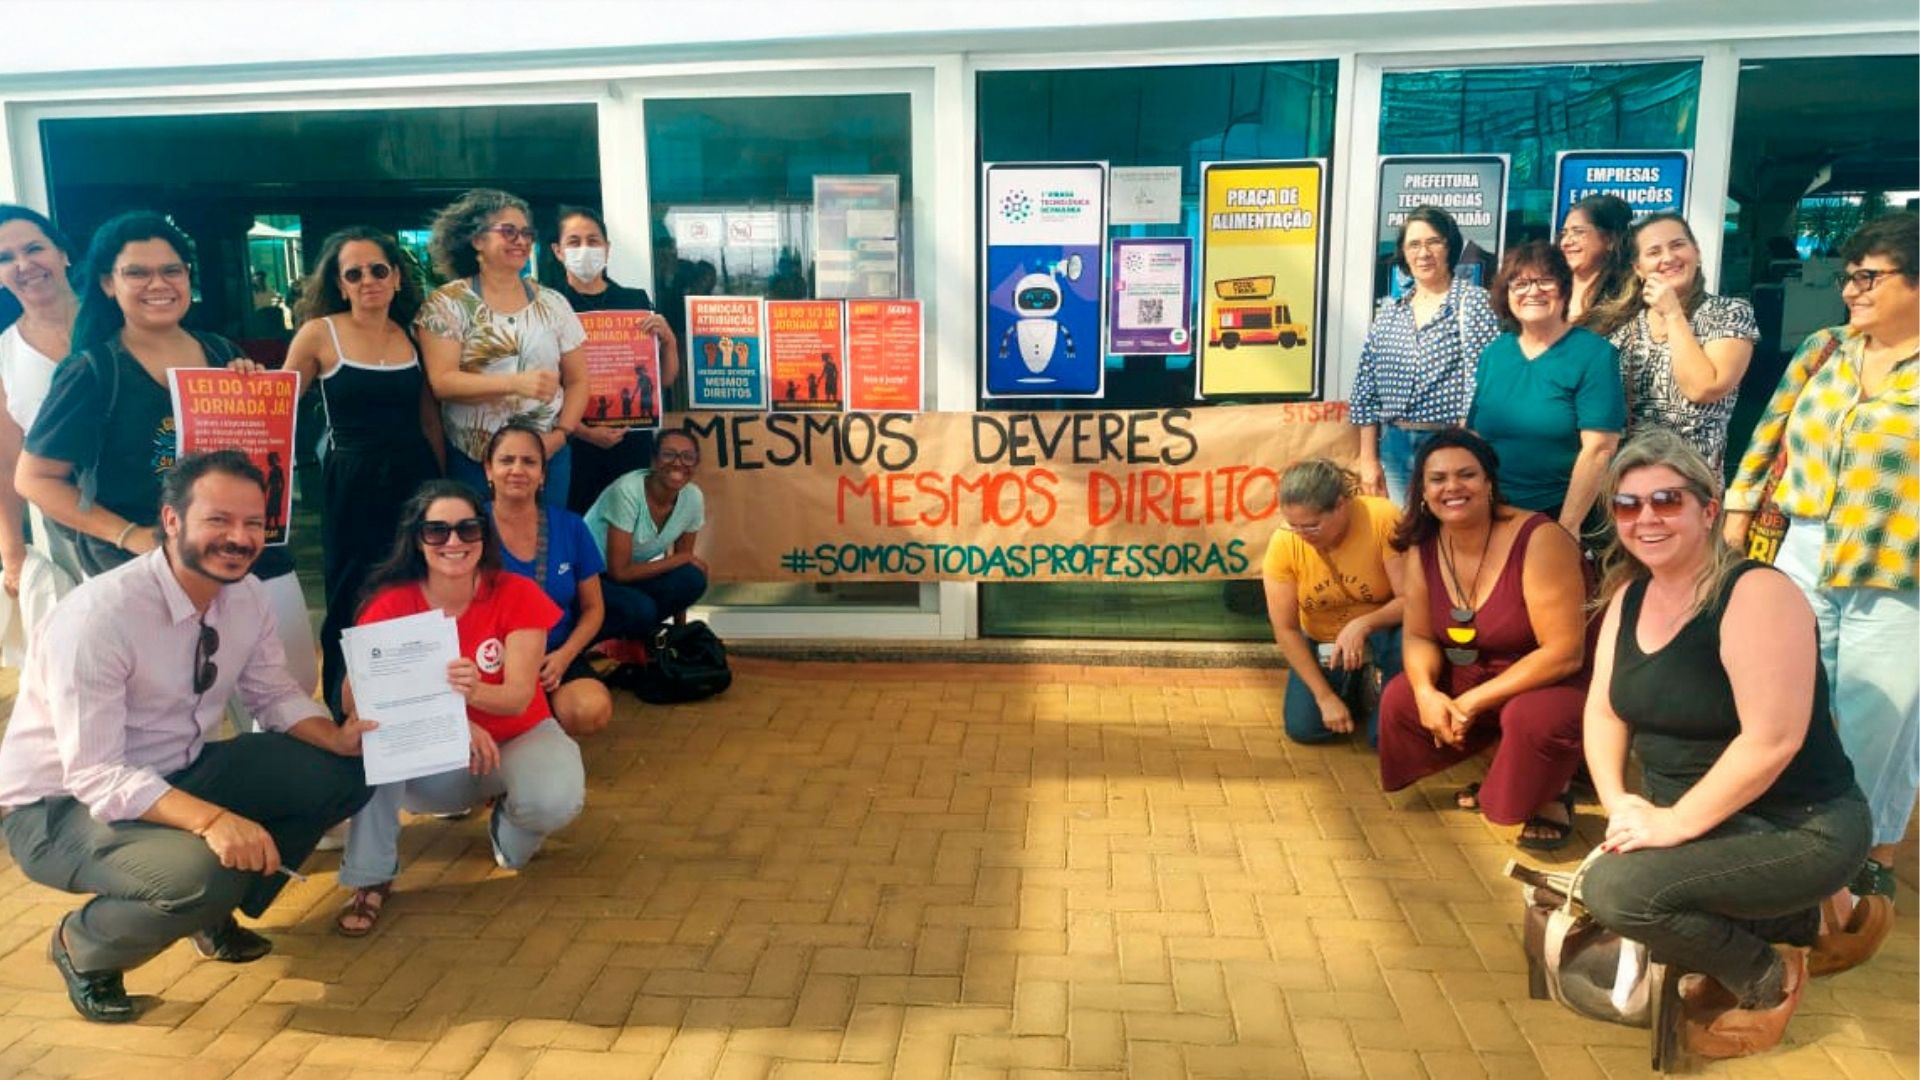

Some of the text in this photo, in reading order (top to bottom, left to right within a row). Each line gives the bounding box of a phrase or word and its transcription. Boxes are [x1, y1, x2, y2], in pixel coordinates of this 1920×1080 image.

[1404, 173, 1479, 188] PREFEITURA
[1587, 167, 1660, 182] EMPRESAS
[1227, 187, 1298, 209] PRAÇA DE
[1399, 192, 1482, 208] TECNOLOGIAS
[1570, 189, 1577, 204] E
[1212, 208, 1312, 231] ALIMENTAÇÃO
[1449, 209, 1491, 226] ADÃO
[187, 379, 292, 396] LEI DO 1/3 DA
[705, 377, 748, 387] MESMOS
[704, 387, 751, 398] DIREITOS
[190, 398, 289, 415] JORNADA JÁ!
[681, 408, 1198, 471] MESMOS DEVERES
[837, 464, 1281, 529] MESMOS DIREITO
[781, 538, 1250, 580] #SOMOSTODASPROFESSORAS
